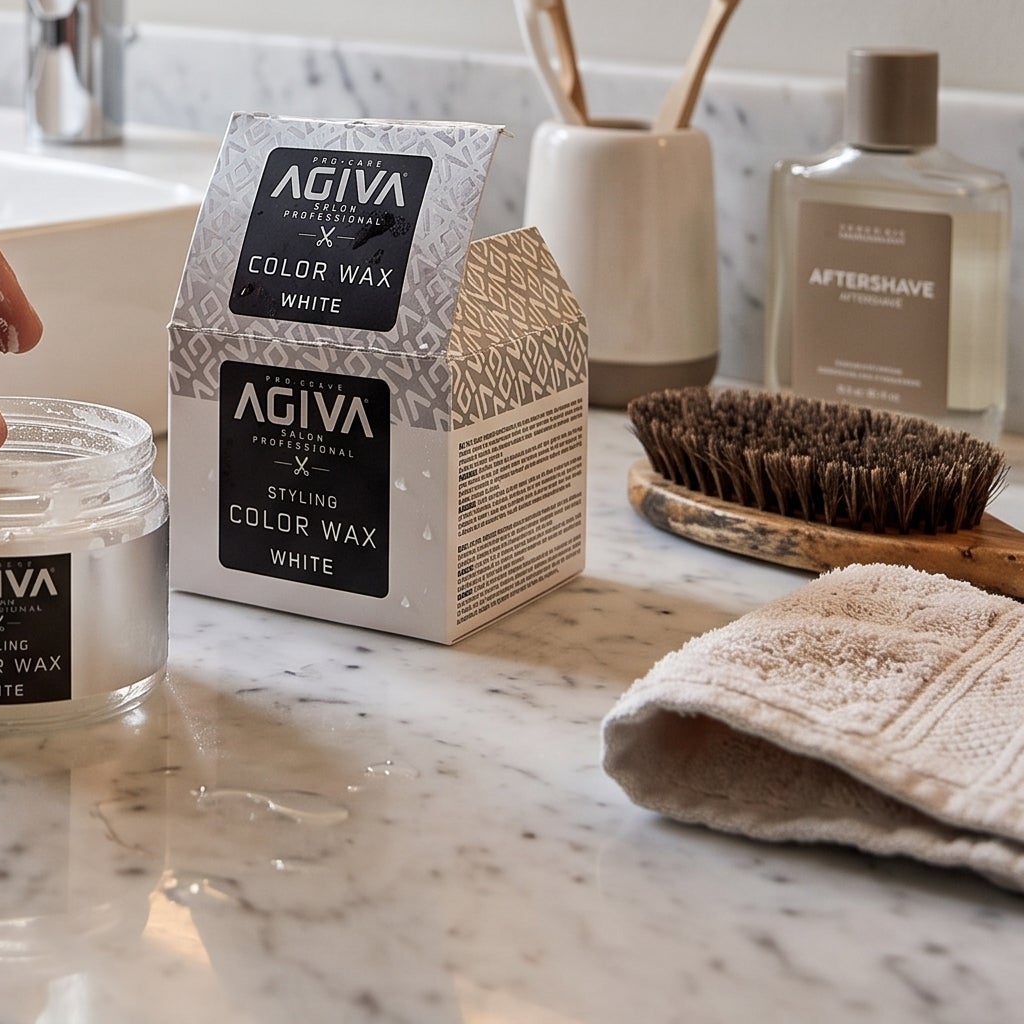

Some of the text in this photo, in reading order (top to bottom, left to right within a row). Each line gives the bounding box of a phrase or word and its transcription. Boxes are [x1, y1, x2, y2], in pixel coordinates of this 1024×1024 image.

[270, 164, 405, 207] AGIVA
[283, 210, 382, 226] PROFESSIONAL
[248, 255, 394, 289] COLOR WAX
[808, 267, 936, 299] AFTERSHAVE
[280, 292, 342, 314] WHITE
[233, 381, 374, 438] AGIVA
[252, 435, 354, 458] PROFESSIONAL
[281, 428, 324, 443] SALON
[267, 485, 338, 509] STYLING
[229, 504, 377, 549] COLOR WAX
[270, 548, 334, 576] WHITE
[14, 655, 62, 673] WAX
